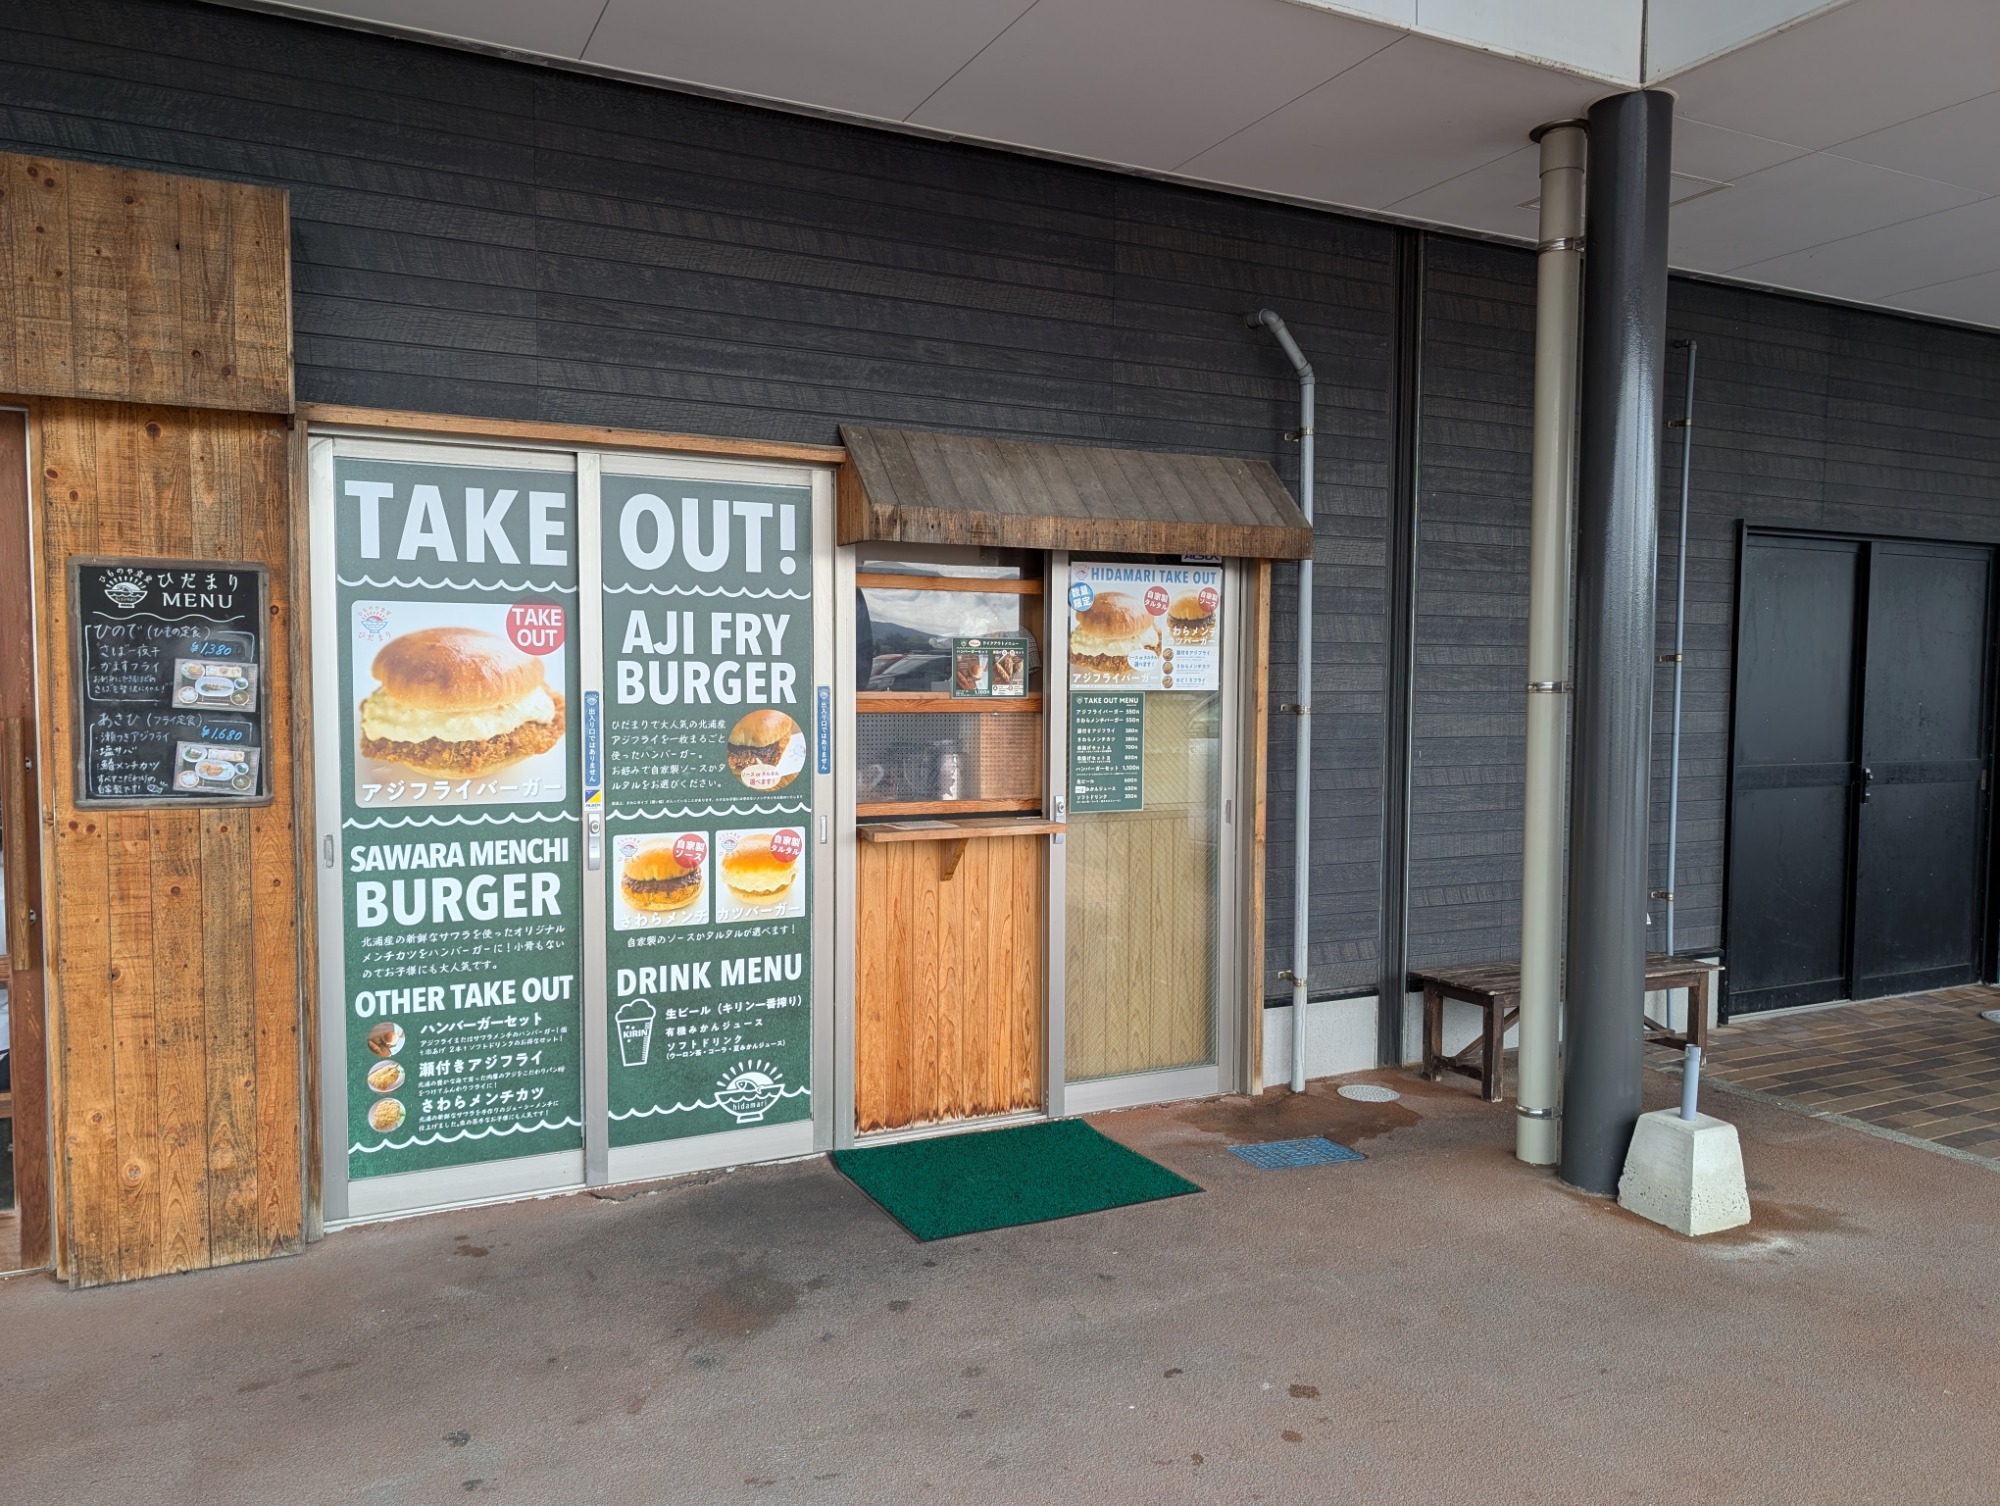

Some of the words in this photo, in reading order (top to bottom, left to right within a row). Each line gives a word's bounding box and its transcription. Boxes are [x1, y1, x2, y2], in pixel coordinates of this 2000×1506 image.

[344, 480, 567, 566] TAKE
[619, 493, 796, 575] OUT!
[157, 572, 238, 591] ひだまり
[1091, 567, 1155, 582] HIDAMARI
[1159, 569, 1189, 583] TAKE
[1193, 571, 1217, 585] OUT
[162, 593, 233, 608] MENU
[512, 608, 562, 626] TAKE
[517, 629, 557, 647] OUT
[621, 610, 694, 655] AJI
[711, 612, 791, 656] FRY
[617, 660, 797, 705] BURGER
[611, 719, 726, 730] ひだまりで大人気の北浦産
[588, 707, 596, 782] 出入り口ではありません
[611, 734, 726, 745] アジフライを一枚まるごと
[611, 764, 726, 776] お好みで自家製ソースかタ
[362, 777, 563, 802] アジフライバーガー
[675, 839, 705, 852] 自家製
[773, 834, 801, 847] 自家製
[350, 842, 465, 872] SAWARA
[470, 837, 569, 866] MENCHI
[675, 850, 702, 861] ソース
[770, 845, 800, 856] タルタル
[356, 872, 562, 928] BURGER
[617, 961, 712, 996] DRINK
[721, 953, 802, 987] MENU
[354, 986, 445, 1018] OTHER
[450, 980, 516, 1009] TAKE
[522, 975, 574, 1003] OUT
[420, 1012, 542, 1034] ハンバーガーセット
[665, 1018, 763, 1037] 有機みかんジュース
[623, 1029, 648, 1039] KIRIN
[667, 1035, 743, 1051] ソフトドリンク
[419, 1050, 543, 1078] 瀬付きアジフライ
[422, 1087, 544, 1113] さわらメンチカツ
[732, 1100, 768, 1112] hidamari
